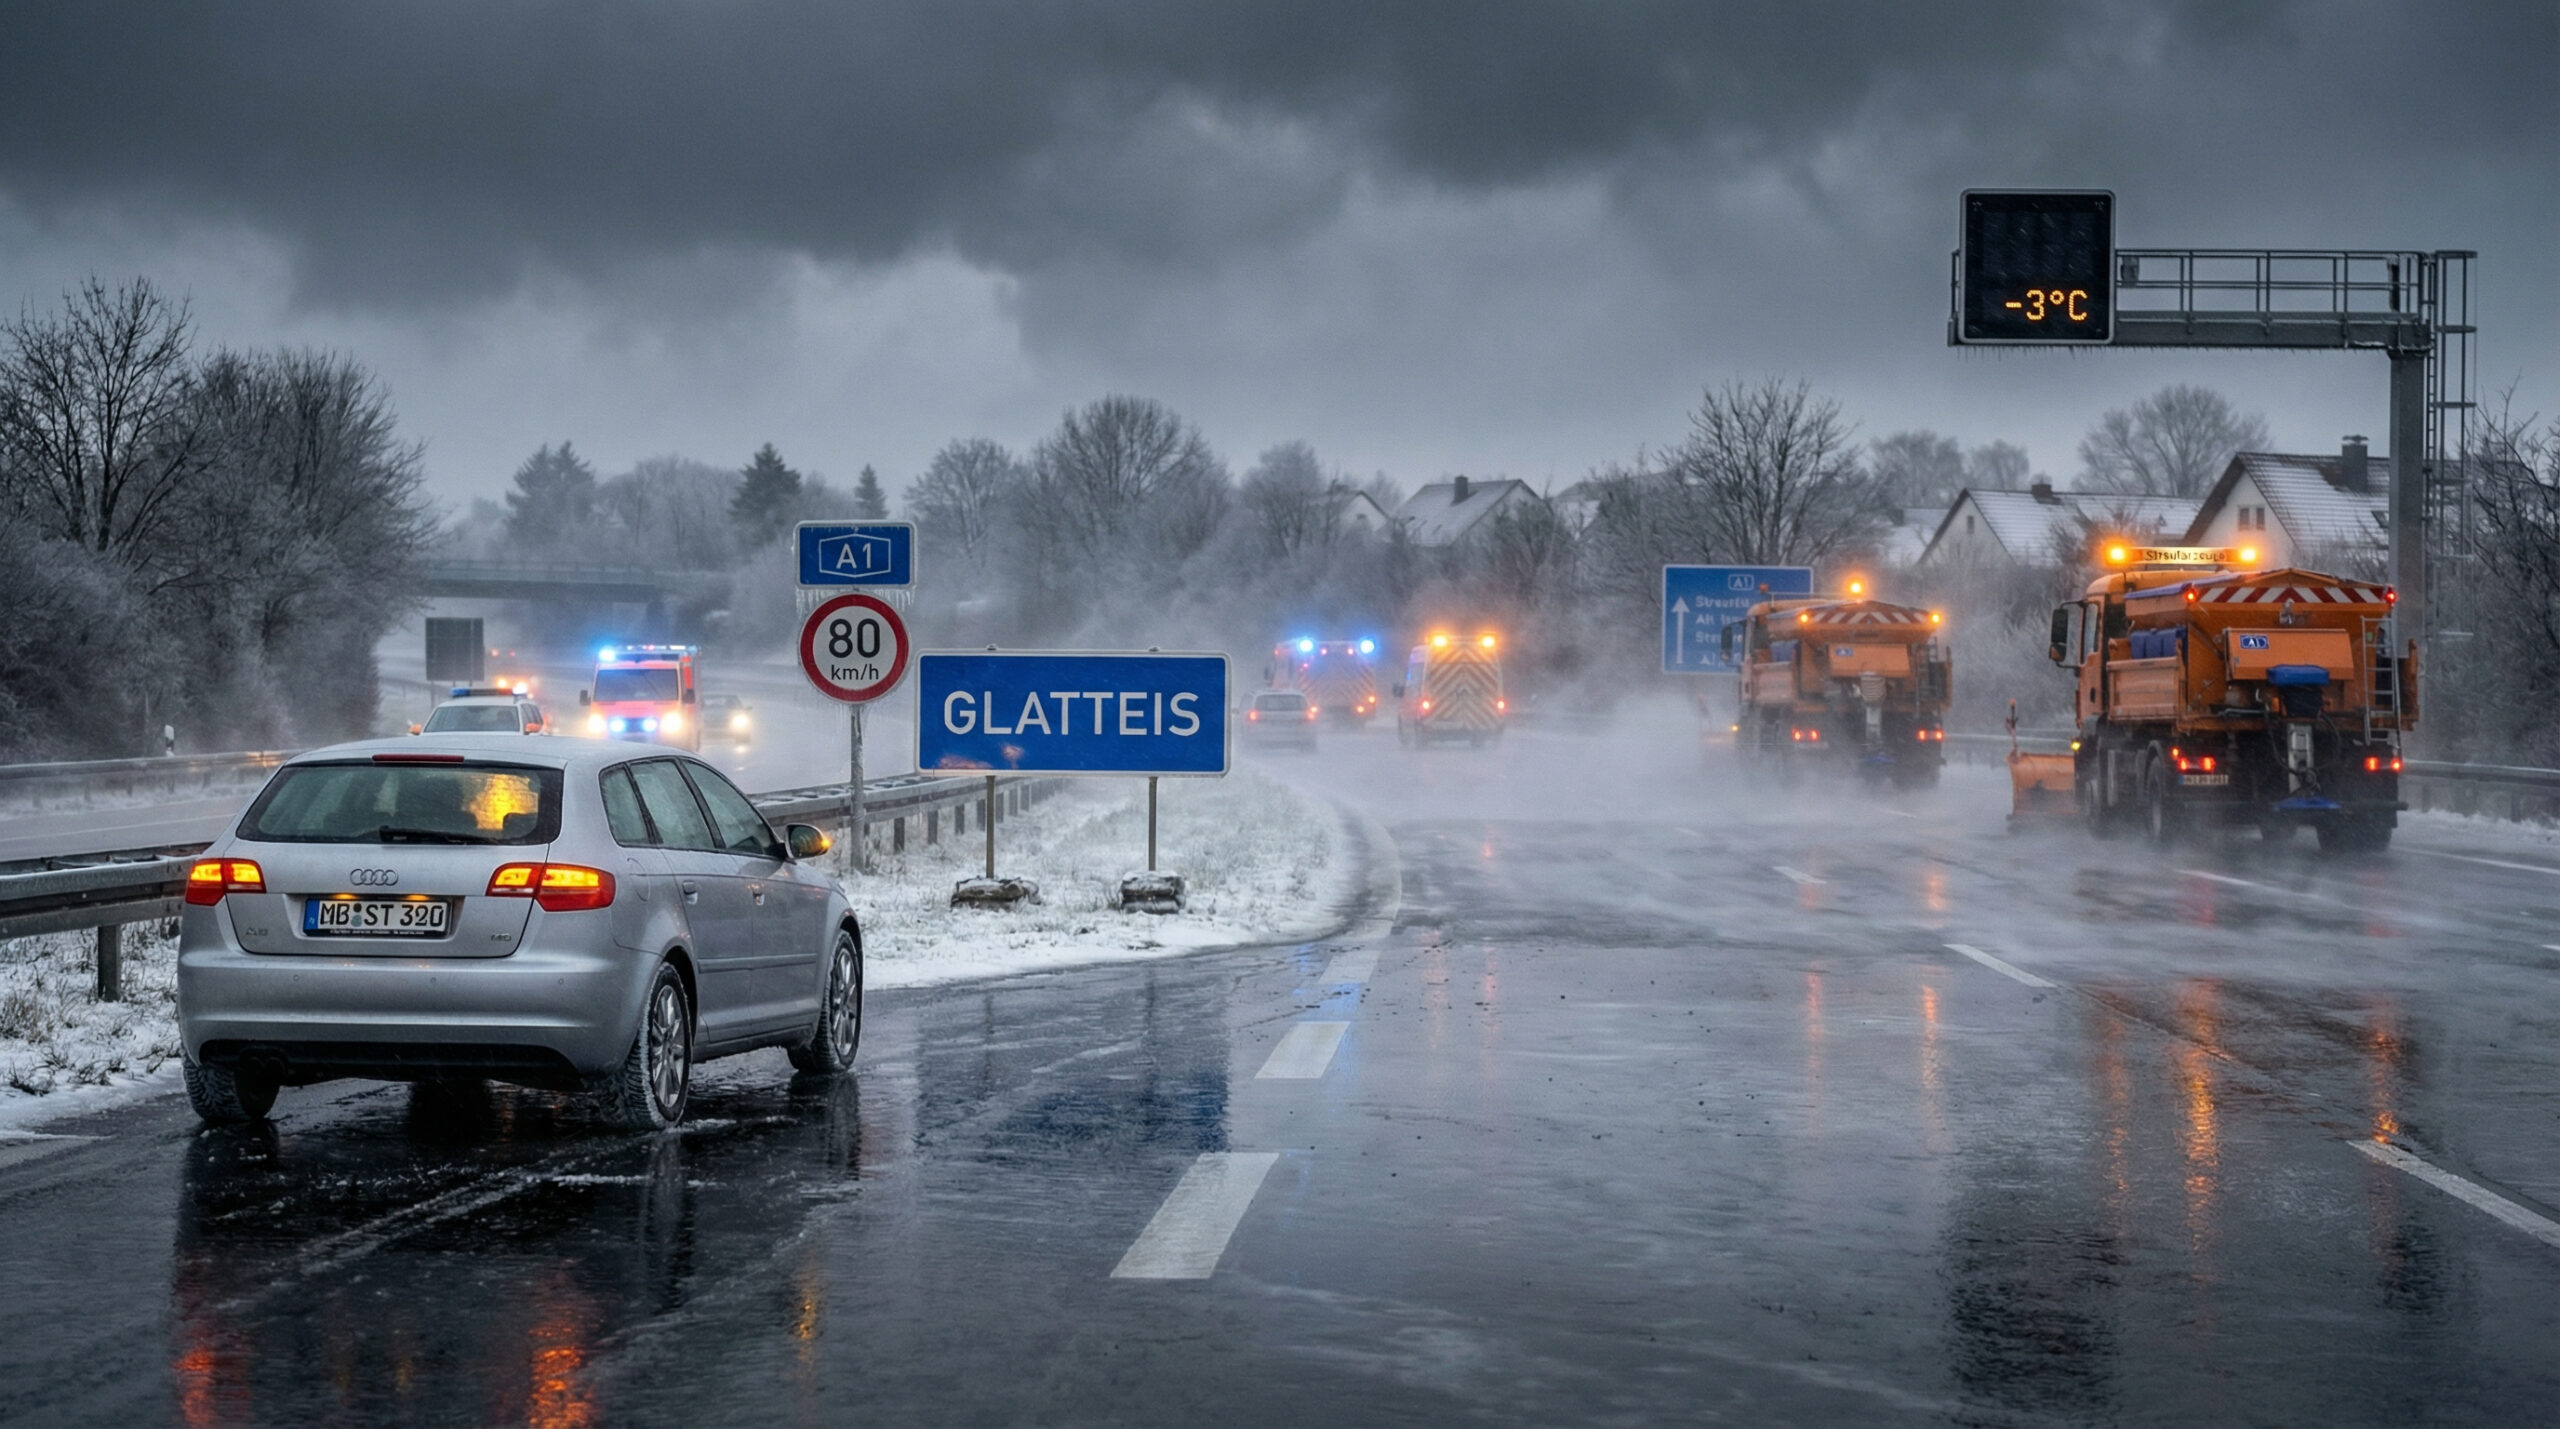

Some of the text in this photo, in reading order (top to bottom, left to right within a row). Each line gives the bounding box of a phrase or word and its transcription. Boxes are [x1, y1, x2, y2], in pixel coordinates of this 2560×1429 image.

[2005, 289, 2088, 321] -3°C
[836, 542, 872, 569] A1
[828, 618, 881, 659] 80
[831, 663, 879, 681] km/h
[944, 690, 1200, 736] GLATTEIS
[319, 903, 350, 926] MB
[364, 904, 394, 927] ST
